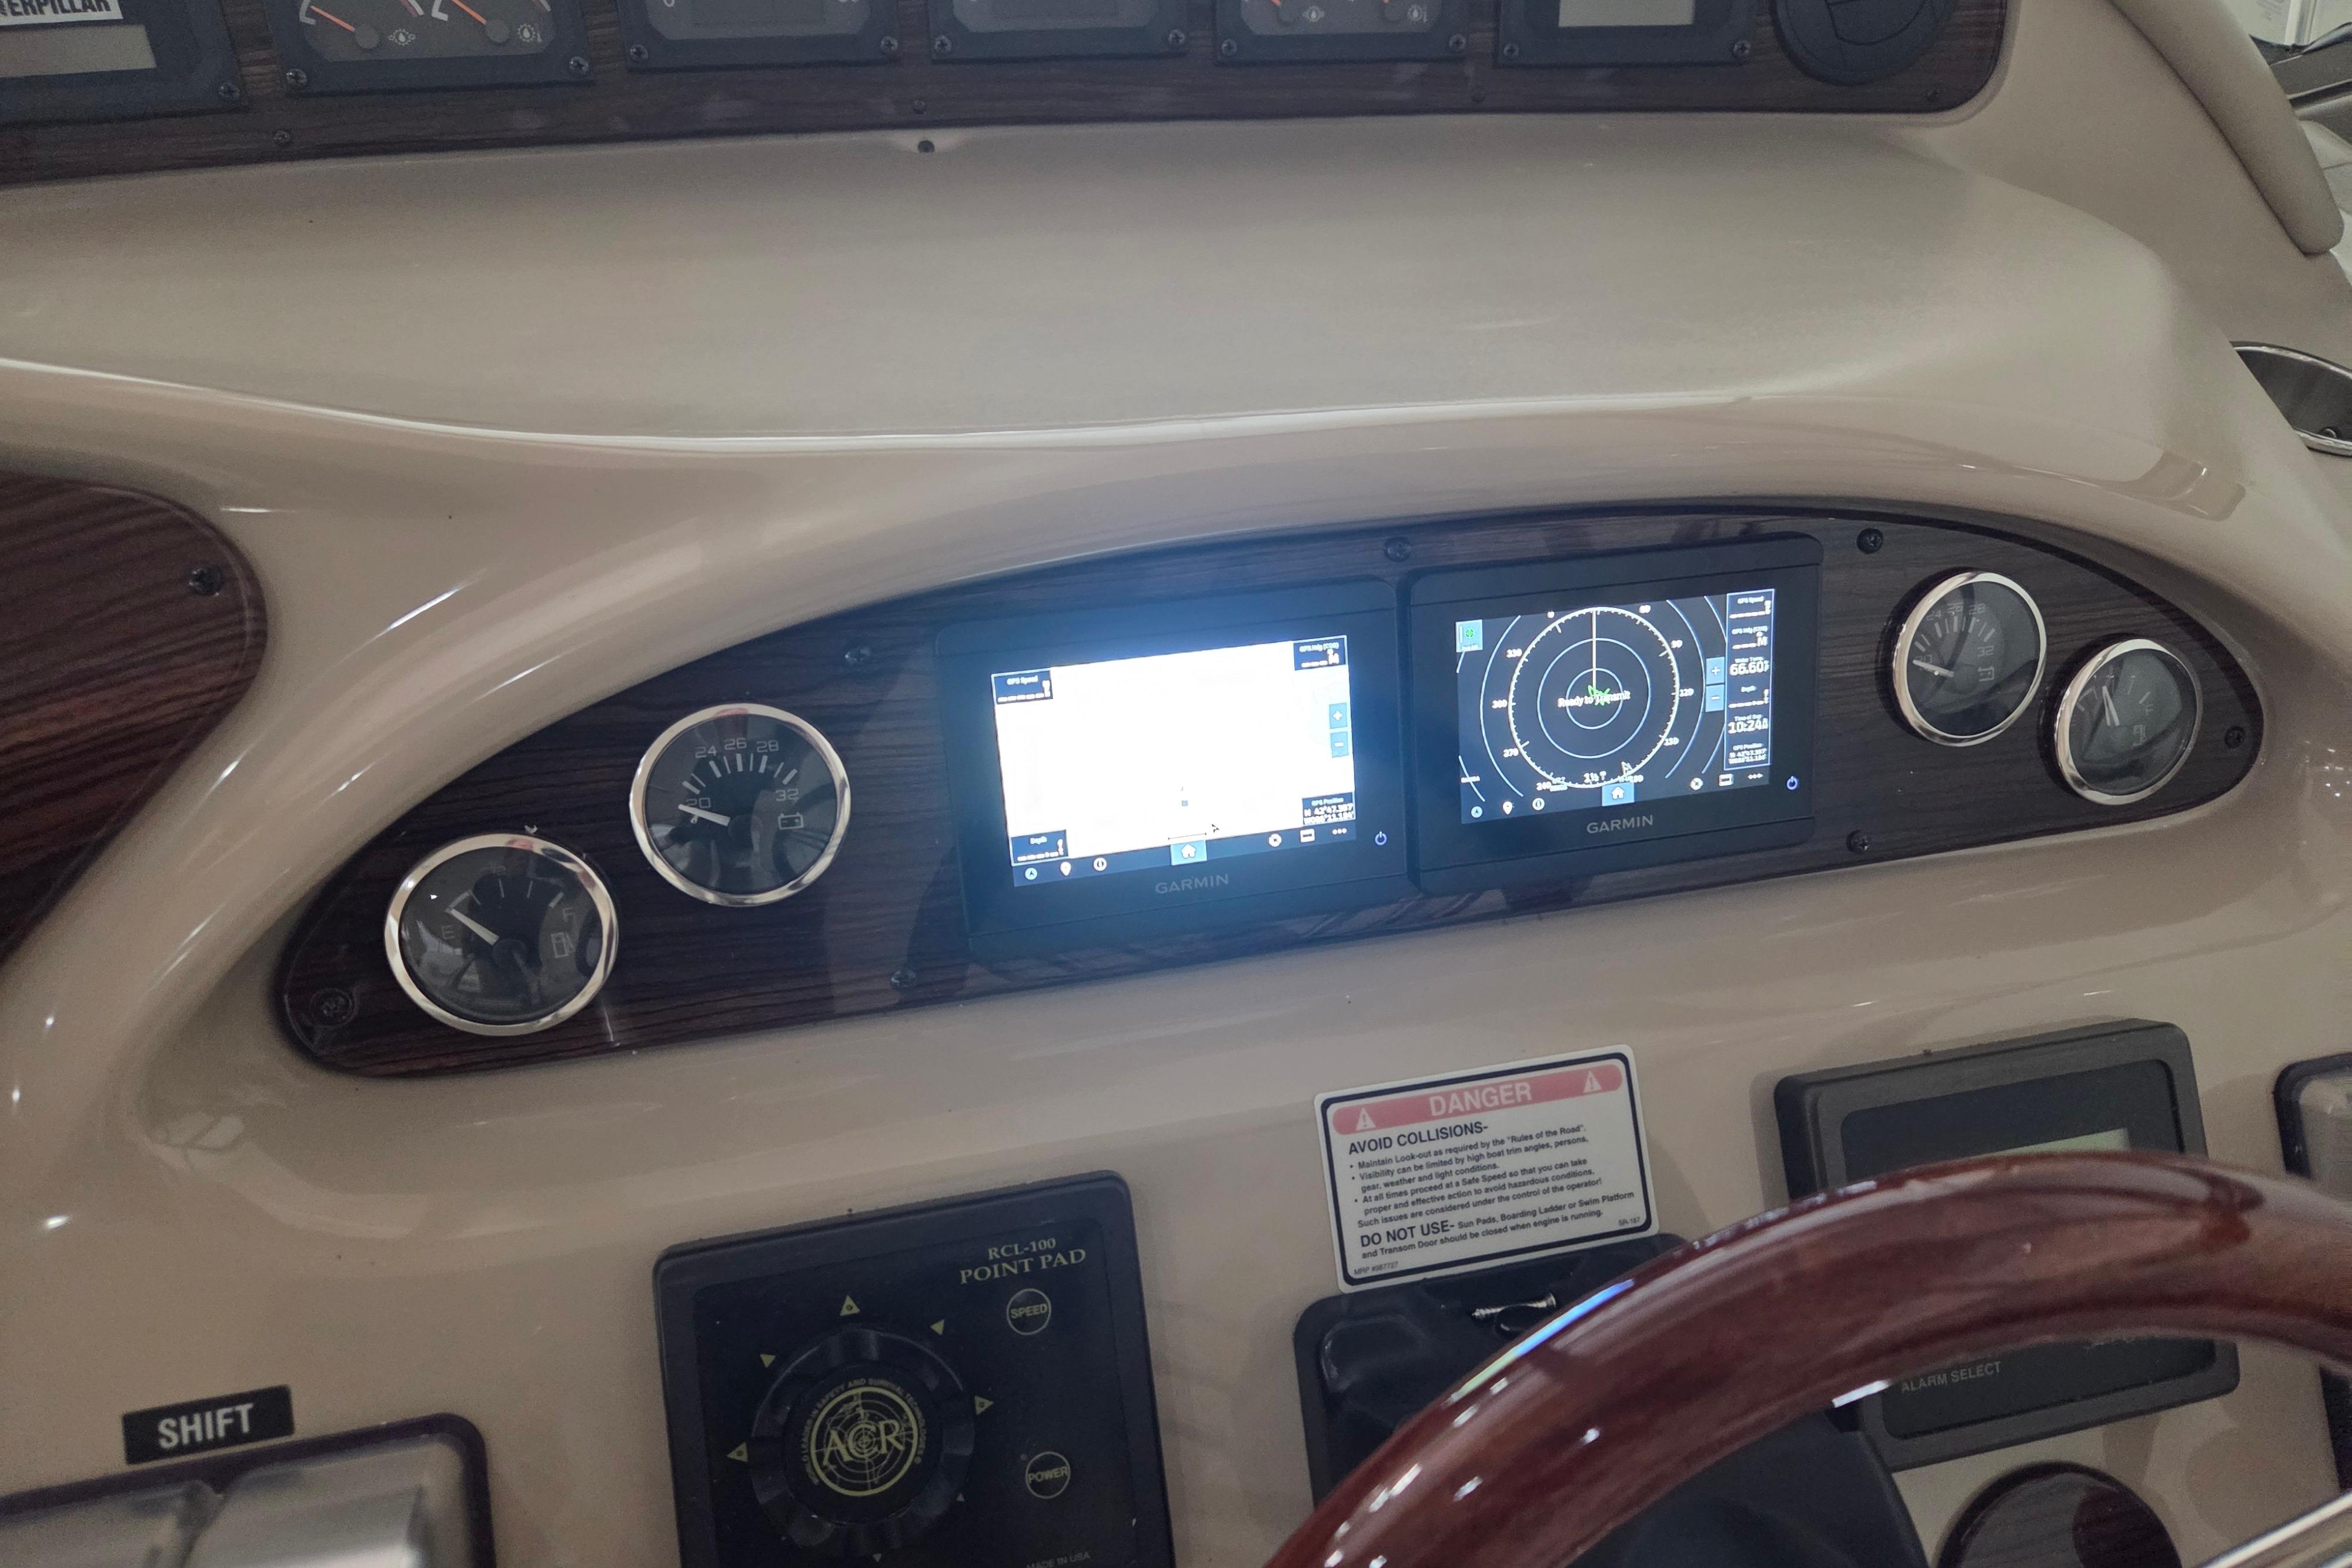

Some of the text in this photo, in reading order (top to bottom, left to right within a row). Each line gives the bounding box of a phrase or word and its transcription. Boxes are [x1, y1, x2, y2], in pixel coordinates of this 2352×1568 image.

[1977, 645, 1994, 657] 32
[1558, 690, 1631, 707] Ready to Transmit
[695, 745, 717, 758] 24
[724, 737, 747, 751] 26
[756, 740, 779, 753] 28
[686, 797, 711, 809] 20
[775, 788, 800, 801] 32
[1586, 814, 1653, 834] GARMIN
[1155, 873, 1229, 894] GARMIN
[1430, 1082, 1532, 1116] DANGER
[1349, 1121, 1488, 1155] AVOID COLLISIONS-
[1358, 1158, 1393, 1169] Maintain
[1395, 1151, 1432, 1163] Look-out
[1445, 1142, 1479, 1154] required
[1480, 1141, 1490, 1149] by
[1492, 1138, 1505, 1146] the
[1535, 1131, 1544, 1139] of
[1359, 1169, 1395, 1180] Visibility
[1425, 1158, 1454, 1169] limited
[1466, 1153, 1485, 1163] high
[1486, 1149, 1505, 1159] boat
[1506, 1147, 1522, 1155] trim
[1524, 1142, 1552, 1152] angles,
[1554, 1136, 1588, 1148] persons,
[1361, 1163, 1499, 1193] gear, weather and light conditions.
[1364, 1205, 1392, 1216] proper
[1394, 1200, 1409, 1209] and
[1411, 1195, 1445, 1206] effective
[1447, 1190, 1472, 1200] action
[1484, 1183, 1506, 1193] avoid
[1508, 1176, 1549, 1189] hazardous
[1551, 1169, 1595, 1182] conditions.
[1374, 1193, 1384, 1201] all
[1385, 1190, 1408, 1199] times
[1410, 1182, 1444, 1196] proceed
[1462, 1176, 1480, 1186] Safe
[1481, 1171, 1507, 1183] Speed
[1520, 1167, 1536, 1175] that
[1538, 1165, 1553, 1174] you
[1571, 1158, 1587, 1166] take
[1358, 1218, 1379, 1228] Such
[1381, 1213, 1408, 1223] issues
[1425, 1201, 1471, 1216] considered
[1472, 1198, 1495, 1207] under
[1512, 1188, 1540, 1200] control
[1542, 1186, 1550, 1195] of
[1566, 1177, 1602, 1191] operator!
[1361, 1232, 1382, 1247] DO
[1386, 1226, 1416, 1242] NOT
[1420, 1219, 1455, 1236] USE-
[1500, 1209, 1537, 1221] Boarding
[1538, 1204, 1566, 1215] Ladder
[1578, 1198, 1600, 1207] Swim
[1601, 1192, 1634, 1203] Platform
[1362, 1249, 1378, 1259] and
[1379, 1243, 1416, 1255] Transom
[1418, 1239, 1438, 1248] Door
[1439, 1232, 1468, 1244] should
[1481, 1225, 1508, 1236] closed
[1509, 1222, 1531, 1231] when
[1533, 1217, 1560, 1228] engine
[1571, 1209, 1603, 1220] running.
[988, 1238, 1056, 1260] RCL-100
[960, 1249, 1086, 1284] POINT PAD
[1010, 1303, 1048, 1319] SPEED
[1901, 1360, 2002, 1394] ALARM SELECT
[158, 1403, 254, 1449] SHIFT
[822, 1419, 905, 1469] ACR
[1028, 1466, 1068, 1484] POWER
[1070, 1551, 1091, 1563] USA
